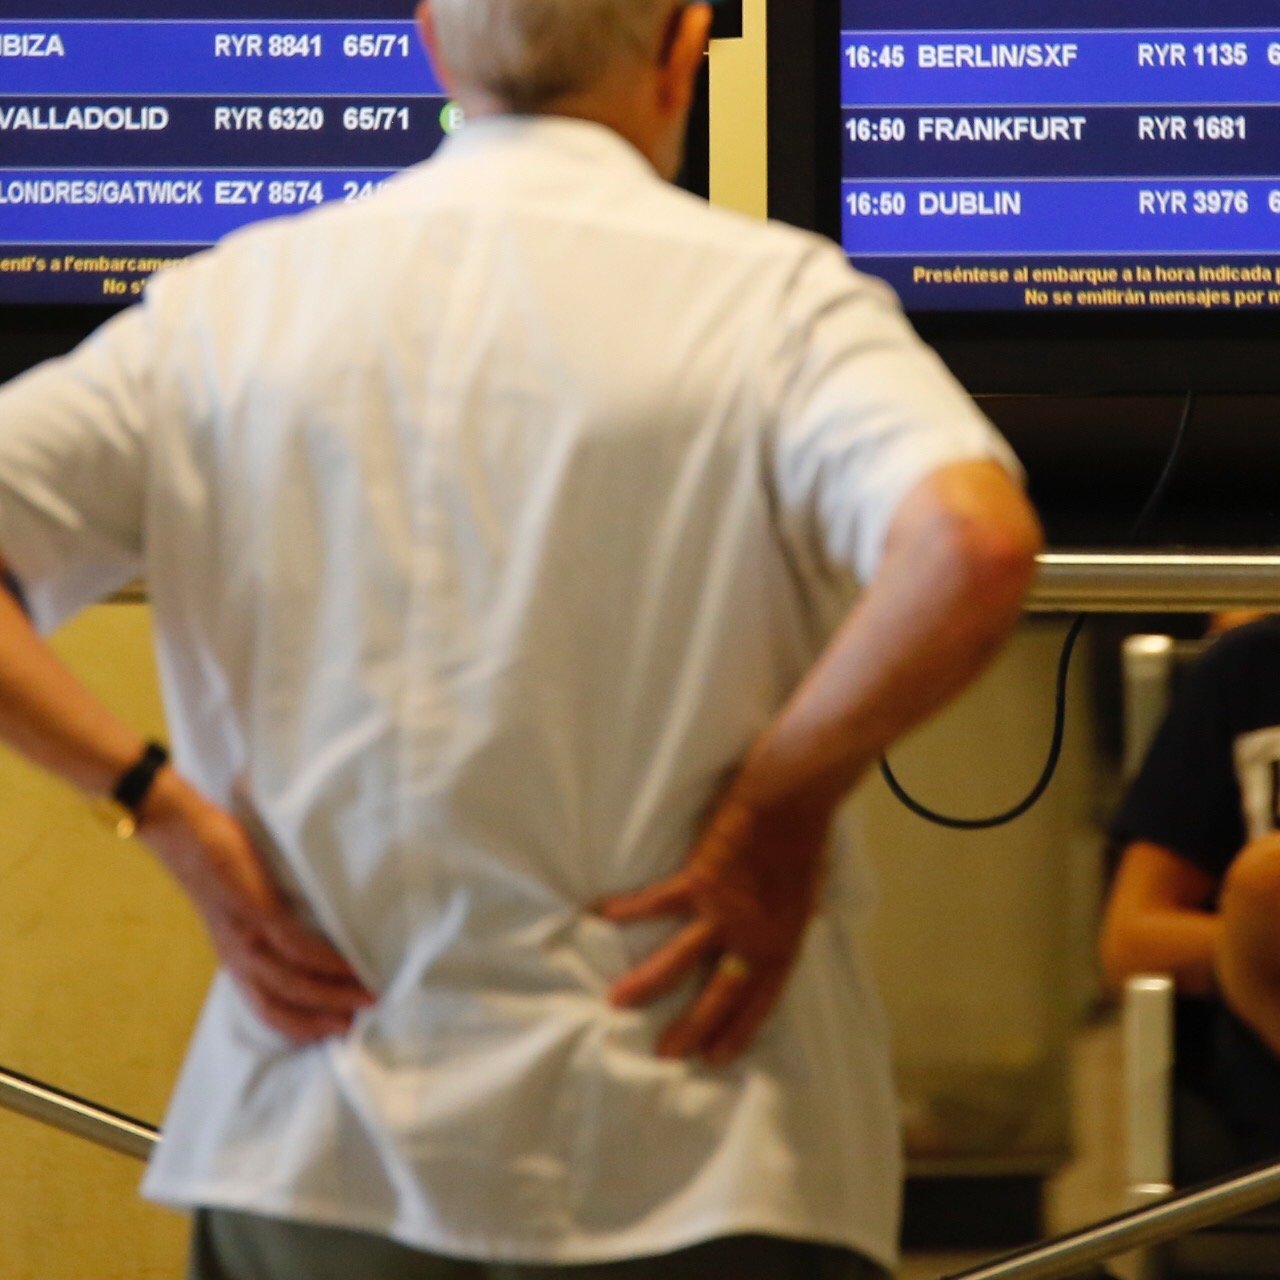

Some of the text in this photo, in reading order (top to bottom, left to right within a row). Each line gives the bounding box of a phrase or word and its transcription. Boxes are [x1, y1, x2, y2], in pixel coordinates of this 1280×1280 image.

[215, 34, 263, 57] RYR
[268, 34, 321, 57] 8841
[343, 34, 409, 57] 65/71
[845, 119, 906, 142] 16:50
[918, 118, 1087, 142] FRANKFURT
[1138, 117, 1187, 140] RYR
[1193, 117, 1246, 140] 1681
